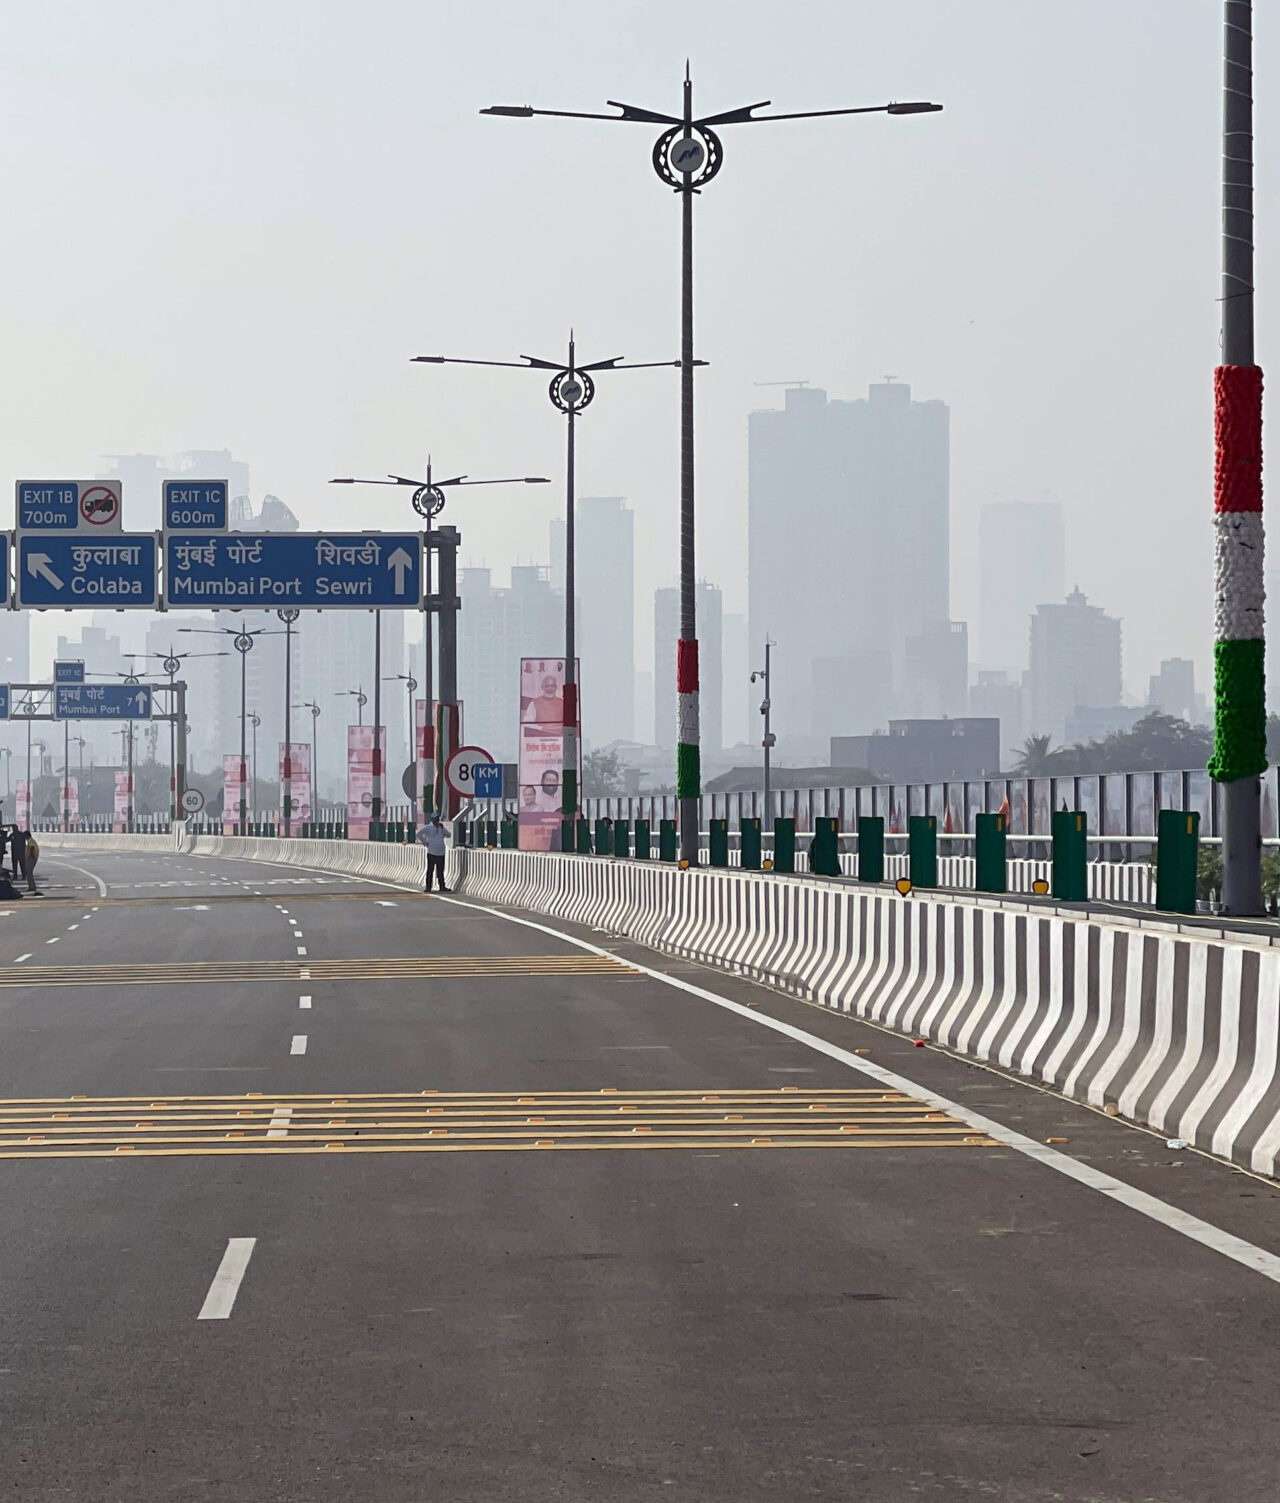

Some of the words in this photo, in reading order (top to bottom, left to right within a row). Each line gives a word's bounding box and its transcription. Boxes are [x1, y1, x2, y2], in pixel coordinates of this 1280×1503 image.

[24, 490, 54, 504] EXIT
[58, 490, 73, 504] 1B
[171, 490, 200, 503] EXIT
[205, 490, 220, 503] 1C
[24, 511, 67, 524] 700m
[171, 511, 215, 524] 600m
[70, 546, 142, 572] कुलाबा
[174, 539, 217, 570] मुंबई
[226, 539, 263, 564] पोर्ट
[315, 539, 382, 566] शिवडी
[70, 576, 143, 594] Colaba
[174, 577, 255, 595] Mumbai
[259, 577, 302, 595] Port
[315, 577, 372, 595] Sewri
[59, 686, 82, 703] मुंबई
[126, 697, 133, 707] 7
[59, 705, 97, 714] Mumbai
[100, 705, 121, 714] Port
[479, 767, 498, 779] KM
[484, 782, 489, 794] 1
[186, 796, 198, 806] 60
